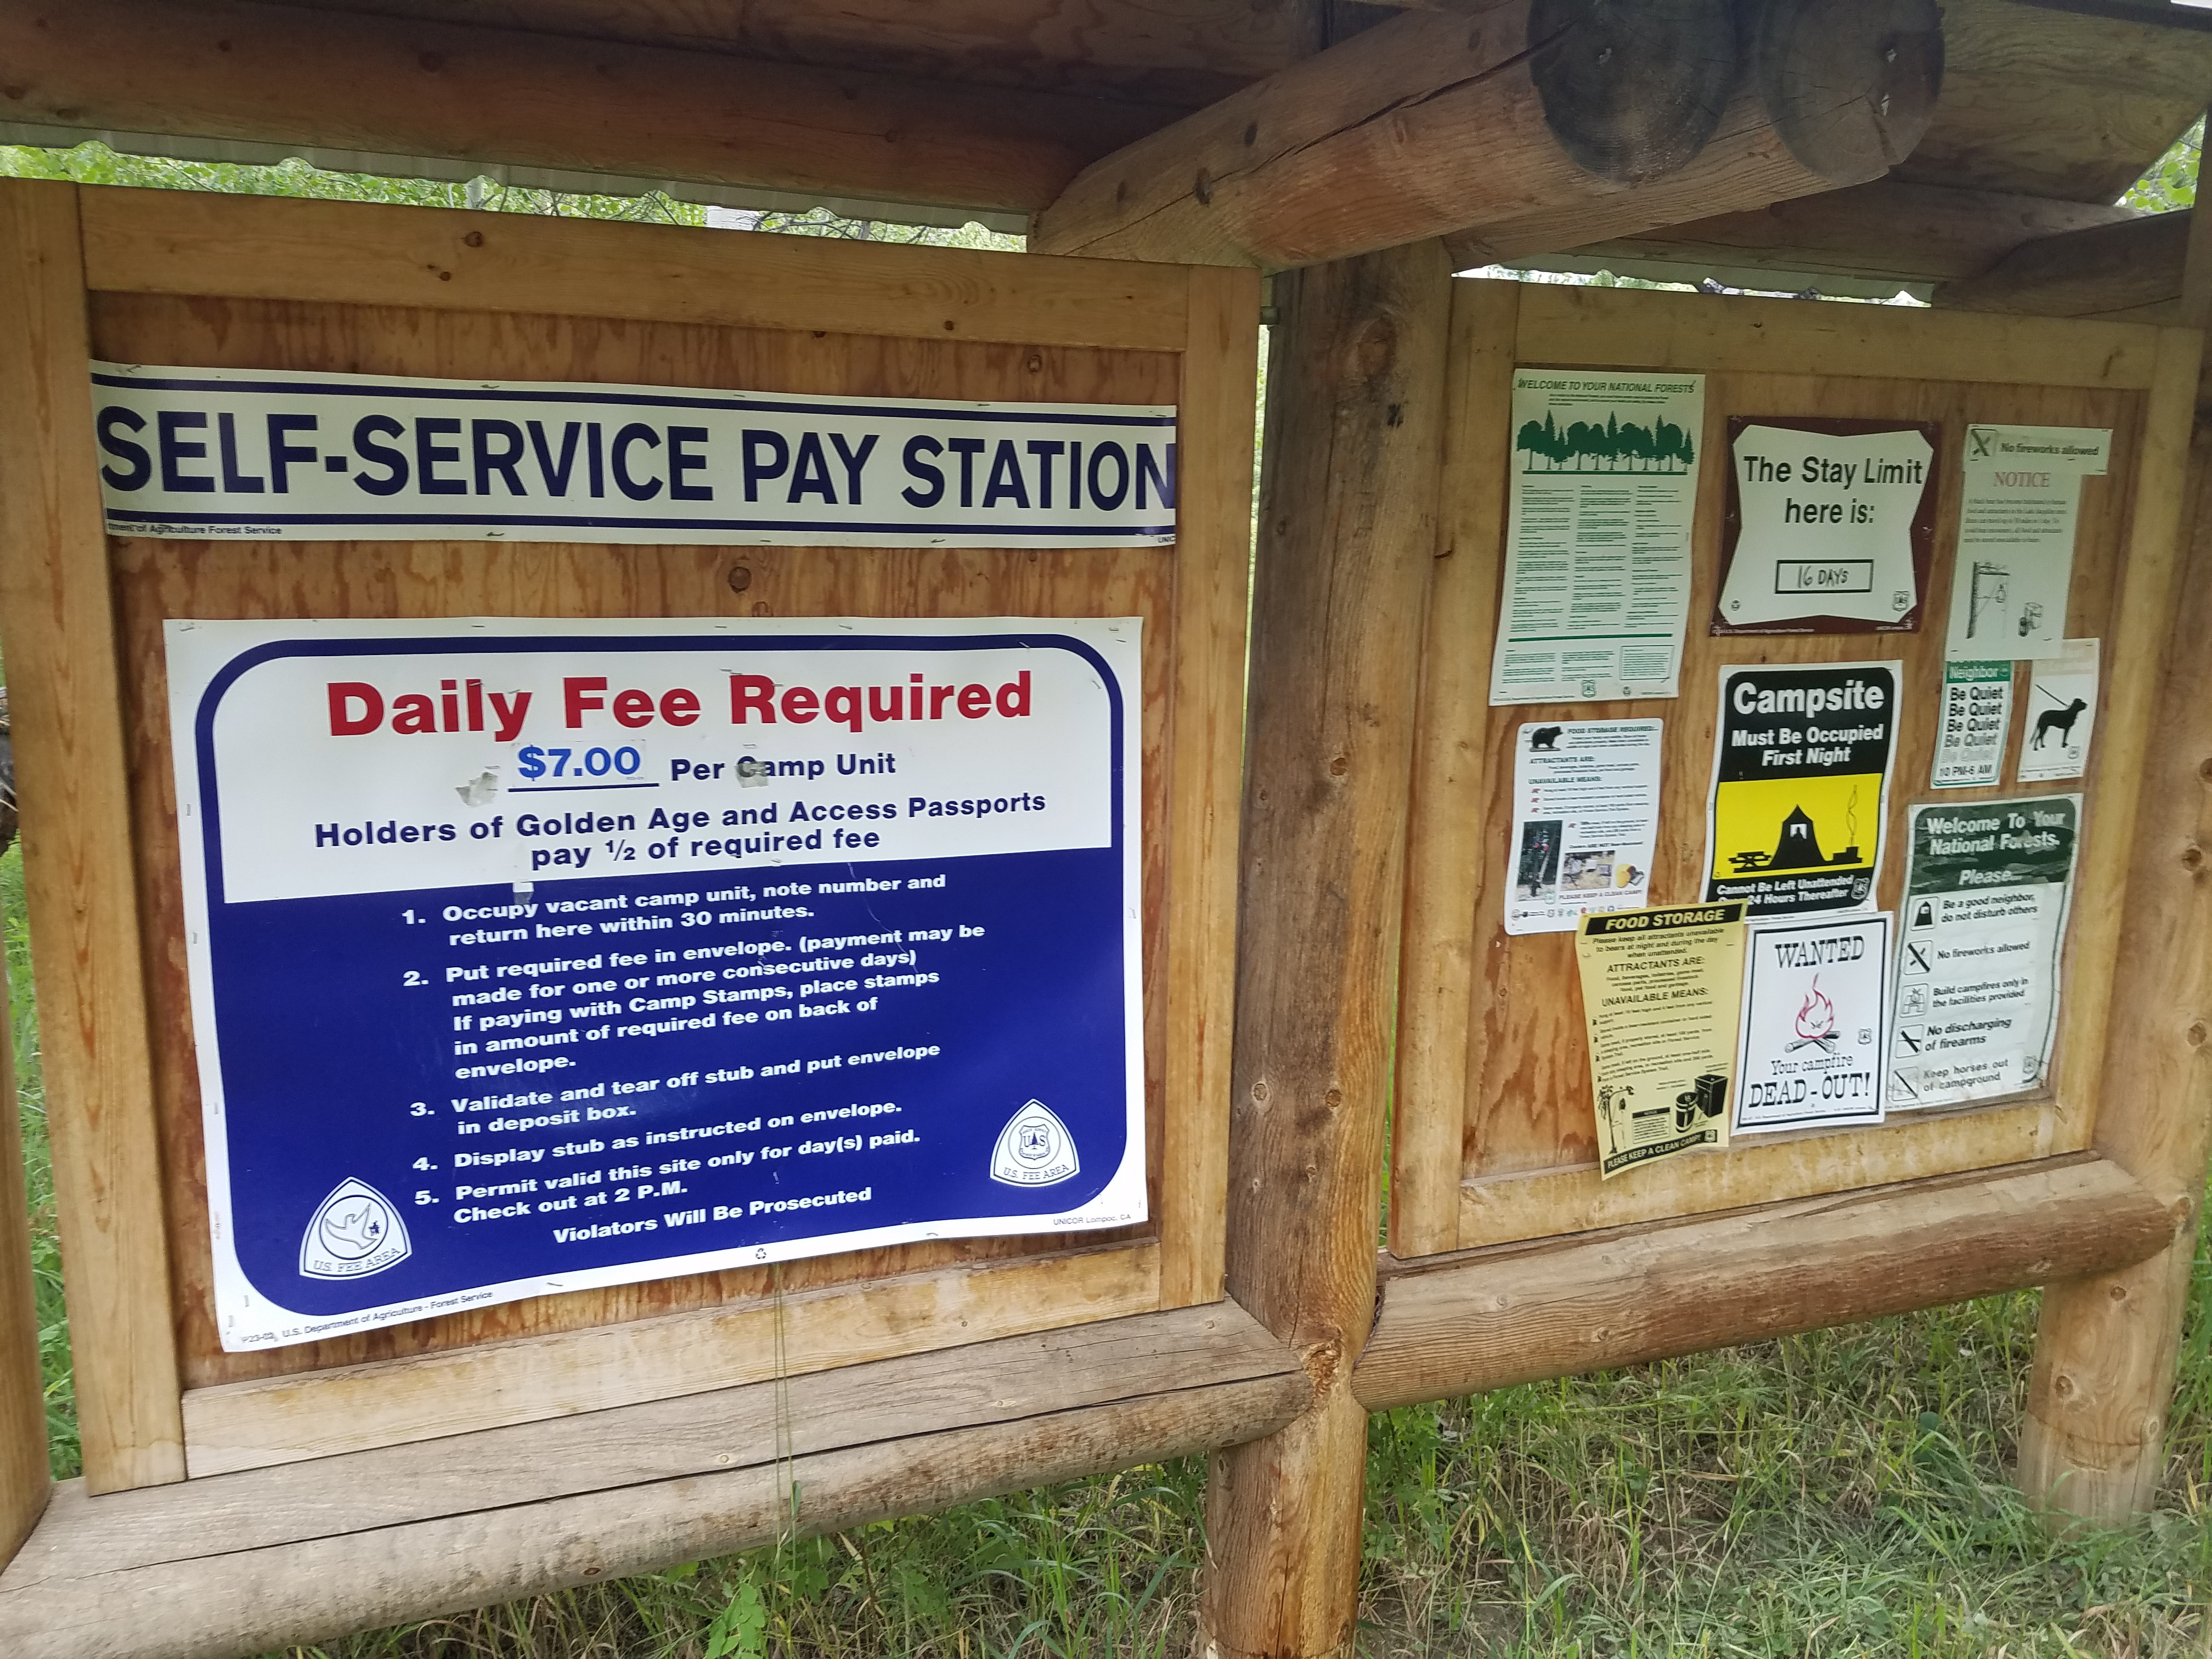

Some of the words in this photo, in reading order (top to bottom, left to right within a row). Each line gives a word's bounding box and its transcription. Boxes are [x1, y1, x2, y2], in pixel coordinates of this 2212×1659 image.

[1518, 379, 1567, 389] WELCOME
[1568, 381, 1581, 391] TO
[1582, 382, 1607, 391] YOUR
[1608, 382, 1652, 392] NATIONAL
[1656, 384, 1695, 393] FORESTS
[97, 405, 713, 501] SELF-SERVICE
[741, 429, 880, 506] PAY
[900, 433, 1176, 512] STATION
[1744, 456, 1791, 482] The
[1802, 456, 1857, 489] Stay
[1864, 458, 1922, 484] Limit
[1993, 472, 2051, 487] NOTICE
[1785, 498, 1843, 523] here
[1850, 498, 1875, 523] is:
[1798, 566, 1813, 588] 16
[1818, 568, 1849, 586] DAYS
[1733, 679, 1884, 718] Campsite
[1950, 687, 1966, 701] Be
[1970, 686, 2003, 700] Quiet
[326, 678, 533, 742] Daily
[562, 676, 701, 727] Fee
[729, 670, 1032, 733] Required
[1949, 703, 1965, 716] Be
[1969, 702, 2002, 716] Quiet
[1731, 729, 1775, 747] Must
[1779, 728, 1802, 744] Be
[1806, 723, 1884, 744] Occupied
[1948, 719, 1963, 732] Be
[1967, 718, 2001, 731] Quiet
[1945, 734, 1961, 747] Be
[1964, 733, 1997, 747] Quiet
[517, 744, 641, 782] $7.00
[670, 759, 725, 781] Per
[736, 755, 826, 781] Camp
[836, 752, 897, 775] Unit
[1762, 749, 1803, 766] First
[1805, 746, 1852, 766] Night
[315, 820, 457, 848] Holders
[470, 815, 504, 839] of
[516, 811, 635, 836] Golden
[647, 807, 710, 833] Age
[722, 802, 777, 826] and
[789, 801, 897, 822] Access
[909, 792, 1046, 818] Passports
[1927, 816, 2001, 834] Welcome
[2007, 812, 2025, 828] To
[2033, 811, 2066, 827] Your
[531, 846, 591, 871] pay
[648, 836, 679, 859] of
[691, 829, 822, 859] required
[833, 828, 881, 849] fee
[1929, 835, 1995, 855] National
[1717, 883, 1756, 895] Cannot
[1757, 882, 1773, 893] Be
[1774, 880, 1796, 891] Left
[1798, 874, 1854, 889] Unattended
[401, 909, 426, 924] 1.
[443, 903, 539, 921] Occupy
[545, 895, 628, 913] vacant
[635, 890, 699, 909] camp
[706, 886, 756, 902] unit,
[763, 882, 812, 897] note
[819, 878, 901, 894] number
[907, 874, 946, 889] and
[1748, 895, 1762, 905] 24
[1763, 893, 1796, 904] Hours
[1798, 888, 1849, 901] Thereafter
[1942, 900, 1955, 910] Be
[1966, 896, 1990, 909] good
[449, 926, 528, 945] return
[535, 921, 592, 938] here
[599, 916, 673, 933] within
[680, 911, 712, 927] 30
[719, 905, 814, 924] minutes.
[1605, 916, 1650, 930] FOOD
[1652, 909, 1726, 927] STORAGE
[1941, 913, 1954, 923] do
[1955, 911, 1971, 921] not
[1974, 907, 2006, 919] disturb
[2008, 906, 2038, 915] others
[1774, 935, 1865, 969] WANTED
[1937, 950, 1951, 960] No
[1952, 946, 1995, 957] fireworks
[1996, 941, 2030, 953] allowed
[1606, 958, 1679, 973] ATTRACTANTS
[1681, 956, 1705, 965] ARE:
[1601, 992, 1669, 1007] UNAVAILABLE
[1671, 987, 1709, 998] MEANS:
[1933, 986, 1956, 996] Build
[1957, 981, 2001, 994] campfires
[2002, 979, 2020, 989] only
[2021, 977, 2029, 985] in
[1932, 998, 1947, 1008] the
[1949, 995, 1987, 1006] facilities
[1988, 990, 2025, 1003] provided
[1927, 1025, 1943, 1036] No
[1945, 1018, 2012, 1034] discharging
[1925, 1041, 1937, 1051] of
[1940, 1035, 1988, 1049] firearms
[1770, 1059, 1799, 1075] Your
[1801, 1053, 1854, 1074] campfire
[1923, 1068, 1949, 1080] Keep
[1953, 1062, 1988, 1075] horses
[1992, 1059, 2008, 1069] out
[1923, 1082, 1934, 1092] of
[1939, 1072, 2001, 1090] campground
[1607, 1153, 1628, 1169] PLEASE
[1629, 1150, 1646, 1160] KEEP
[1655, 1142, 1679, 1154] CLEAN
[414, 1190, 439, 1205] 5.
[455, 1180, 538, 1200] Permit
[544, 1170, 602, 1190] valid
[608, 1165, 652, 1181] this
[658, 1158, 701, 1174] site
[708, 1150, 755, 1168] only
[760, 1146, 792, 1160] for
[798, 1135, 863, 1155] day(s)
[869, 1129, 921, 1149] paid.
[1003, 1167, 1018, 1179] U.S.
[1042, 1164, 1069, 1179] AREA
[454, 1202, 531, 1223] Check
[538, 1195, 577, 1212] out
[584, 1192, 607, 1206] at
[614, 1188, 630, 1202] 2
[637, 1181, 688, 1199] P.M.
[552, 1218, 658, 1243] Violators
[663, 1208, 707, 1227] Will
[713, 1205, 743, 1221] Be
[749, 1187, 872, 1215] Prosecuted
[1053, 1217, 1084, 1225] UNICOR
[281, 1326, 303, 1337] U.S.
[304, 1316, 359, 1334] Department
[362, 1313, 370, 1324] of
[374, 1305, 422, 1321] Agriculture
[430, 1296, 459, 1310] Forest
[461, 1291, 493, 1304] Service
